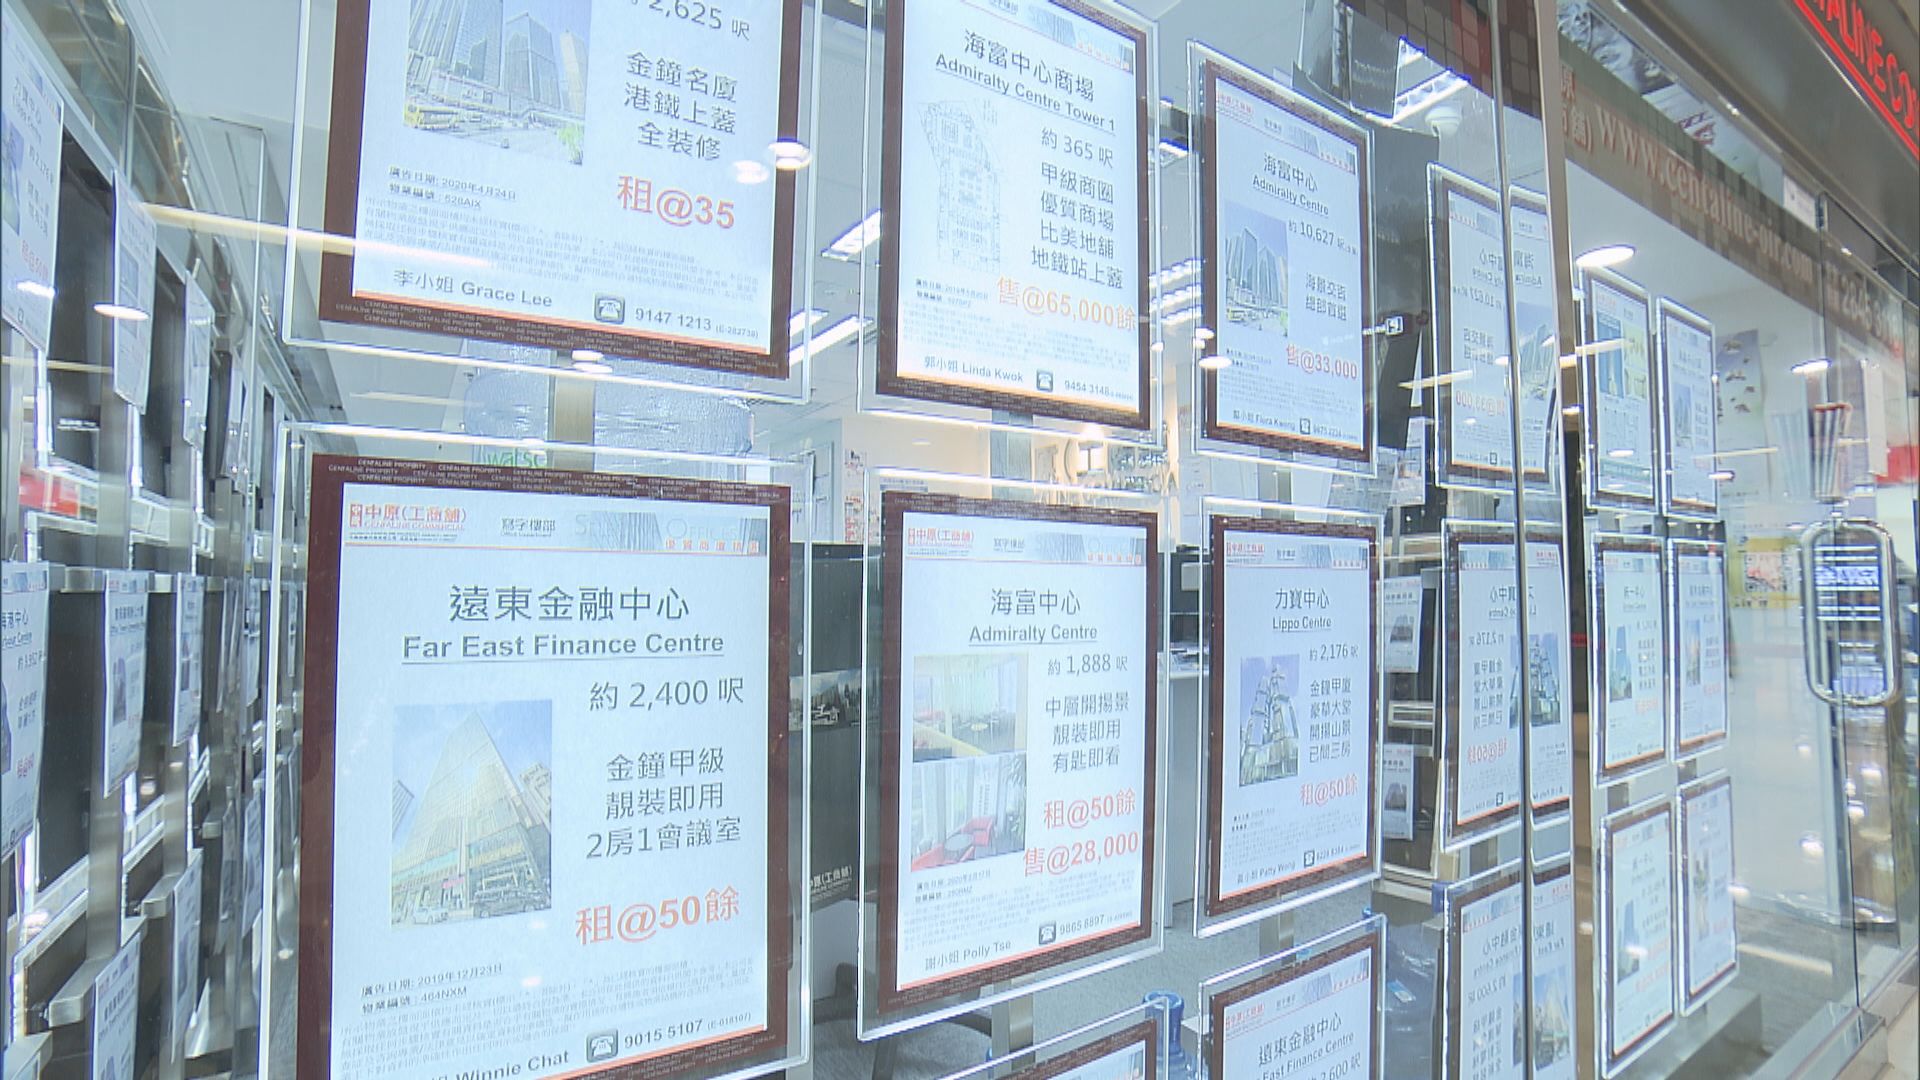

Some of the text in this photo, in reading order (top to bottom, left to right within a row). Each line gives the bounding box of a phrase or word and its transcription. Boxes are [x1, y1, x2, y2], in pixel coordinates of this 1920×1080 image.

[626, 51, 738, 103] 金鐘名廈
[964, 29, 1095, 102] 海富中心商場
[624, 82, 736, 135] 港鐵上蓋
[935, 53, 1115, 131] Admiralty Centre Tower 1
[637, 121, 721, 161] 全裝修
[1041, 127, 1113, 169] 約 365 呎
[617, 175, 735, 229] 租@35
[1252, 174, 1329, 216] Admiralty Centre
[1299, 220, 1334, 246] 10,627
[393, 270, 553, 308] 李小姐 Grace Lee
[997, 276, 1137, 332] 售@65,000餘
[635, 308, 673, 326] 9147
[677, 313, 713, 332] 1213
[962, 364, 992, 378] Linda
[994, 369, 1024, 383] Kwok
[1286, 343, 1358, 380] 售@33,000
[449, 585, 690, 622] 遠東金融中心
[990, 587, 1081, 616] 海富中心
[1275, 587, 1330, 610] 力寶中心
[968, 624, 1098, 644] Admiralty Centre
[1272, 615, 1332, 633] Lippo Centre
[402, 632, 725, 659] Far East Finance Centre
[1320, 643, 1349, 662] 2,176
[1047, 659, 1061, 676] 約
[1066, 653, 1112, 678] 1,888
[589, 676, 744, 711] 約 2,400 呎
[606, 746, 725, 782] 金鐘甲級
[606, 782, 724, 820] 靚裝即用
[1043, 786, 1136, 831] 租@50餘
[586, 815, 742, 860] 2房1會議室
[1023, 831, 1140, 877] 售@28,000
[575, 885, 740, 946] 租@50餘
[963, 944, 990, 962] Polly
[994, 941, 1012, 954] Tse
[624, 1019, 703, 1049] 9015 5107
[455, 1061, 522, 1080] Winnie
[1287, 1051, 1324, 1074] Finance
